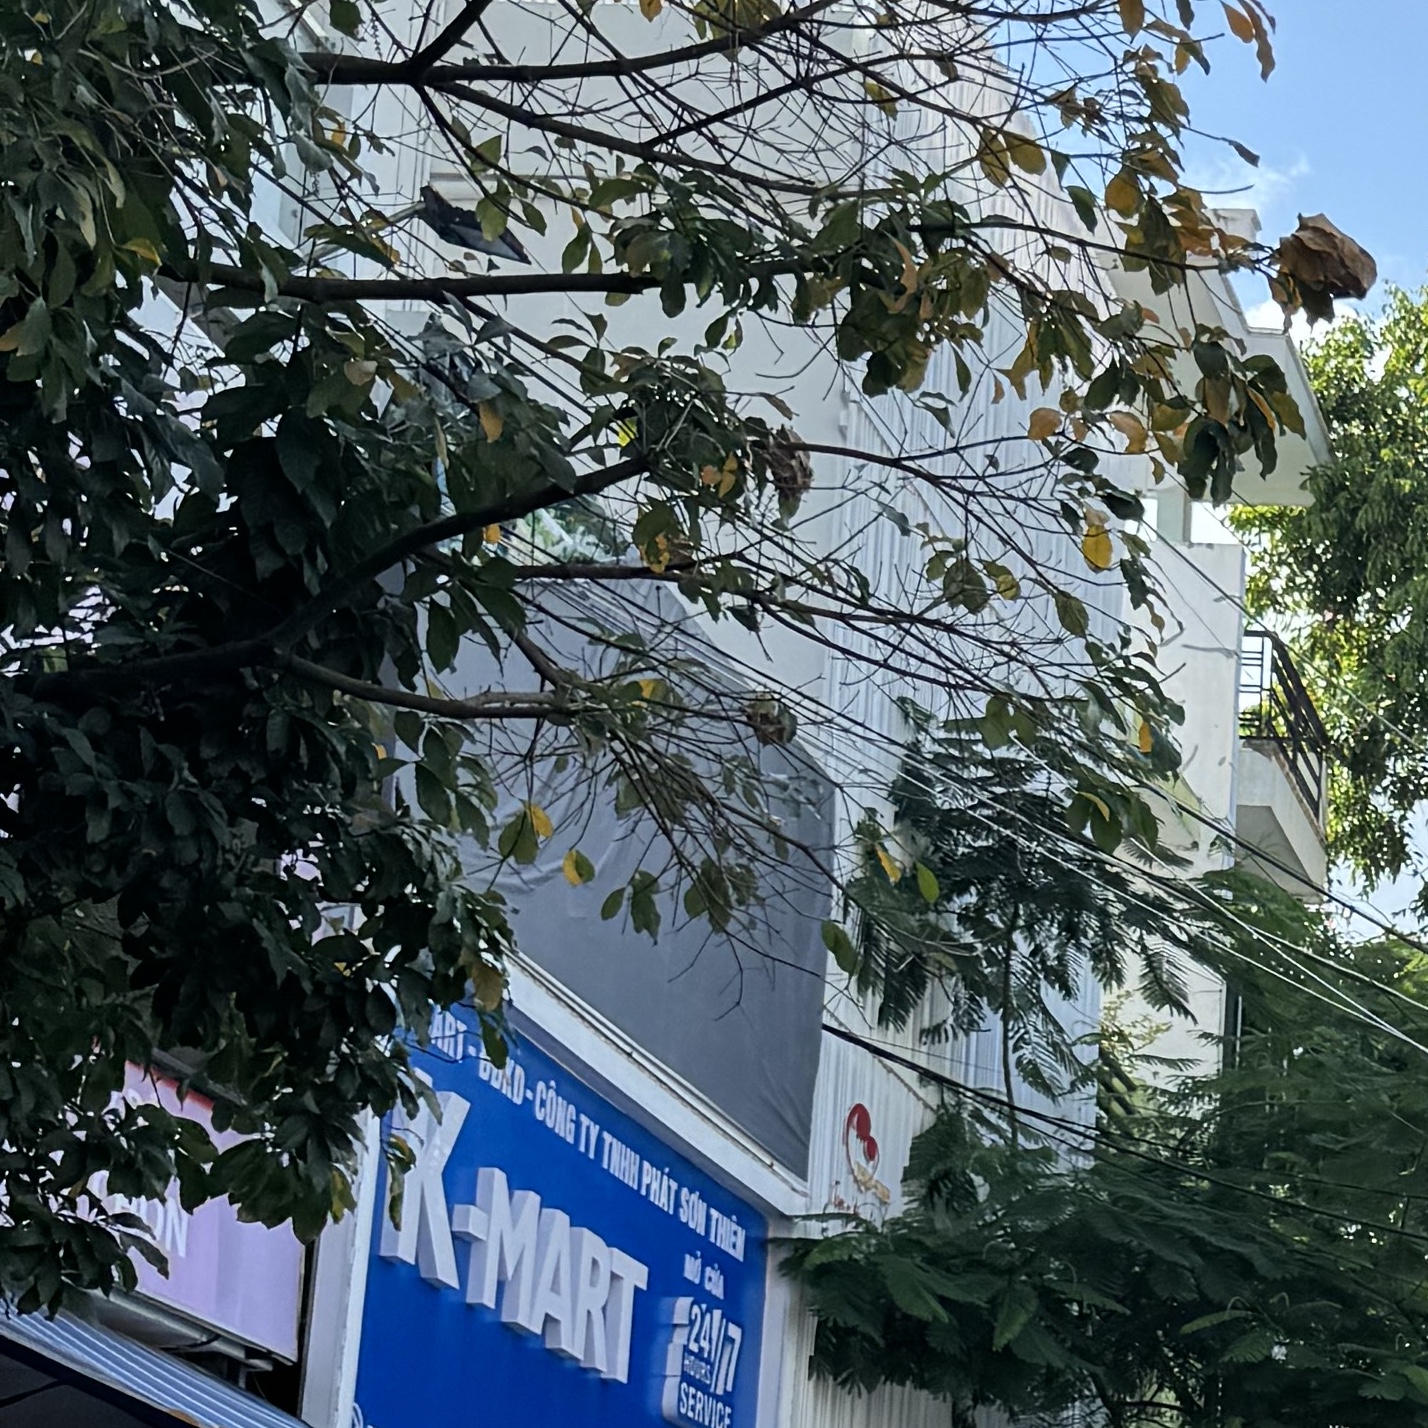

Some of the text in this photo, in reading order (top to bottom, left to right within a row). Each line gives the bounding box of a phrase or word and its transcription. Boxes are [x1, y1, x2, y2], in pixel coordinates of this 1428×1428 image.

[380, 1068, 649, 1385] K-MART
[534, 1080, 576, 1144] CÔNG
[578, 1112, 600, 1159] TY
[602, 1131, 640, 1190] TNHH
[641, 1160, 679, 1215] PHÁT
[680, 1186, 707, 1236] SƠN
